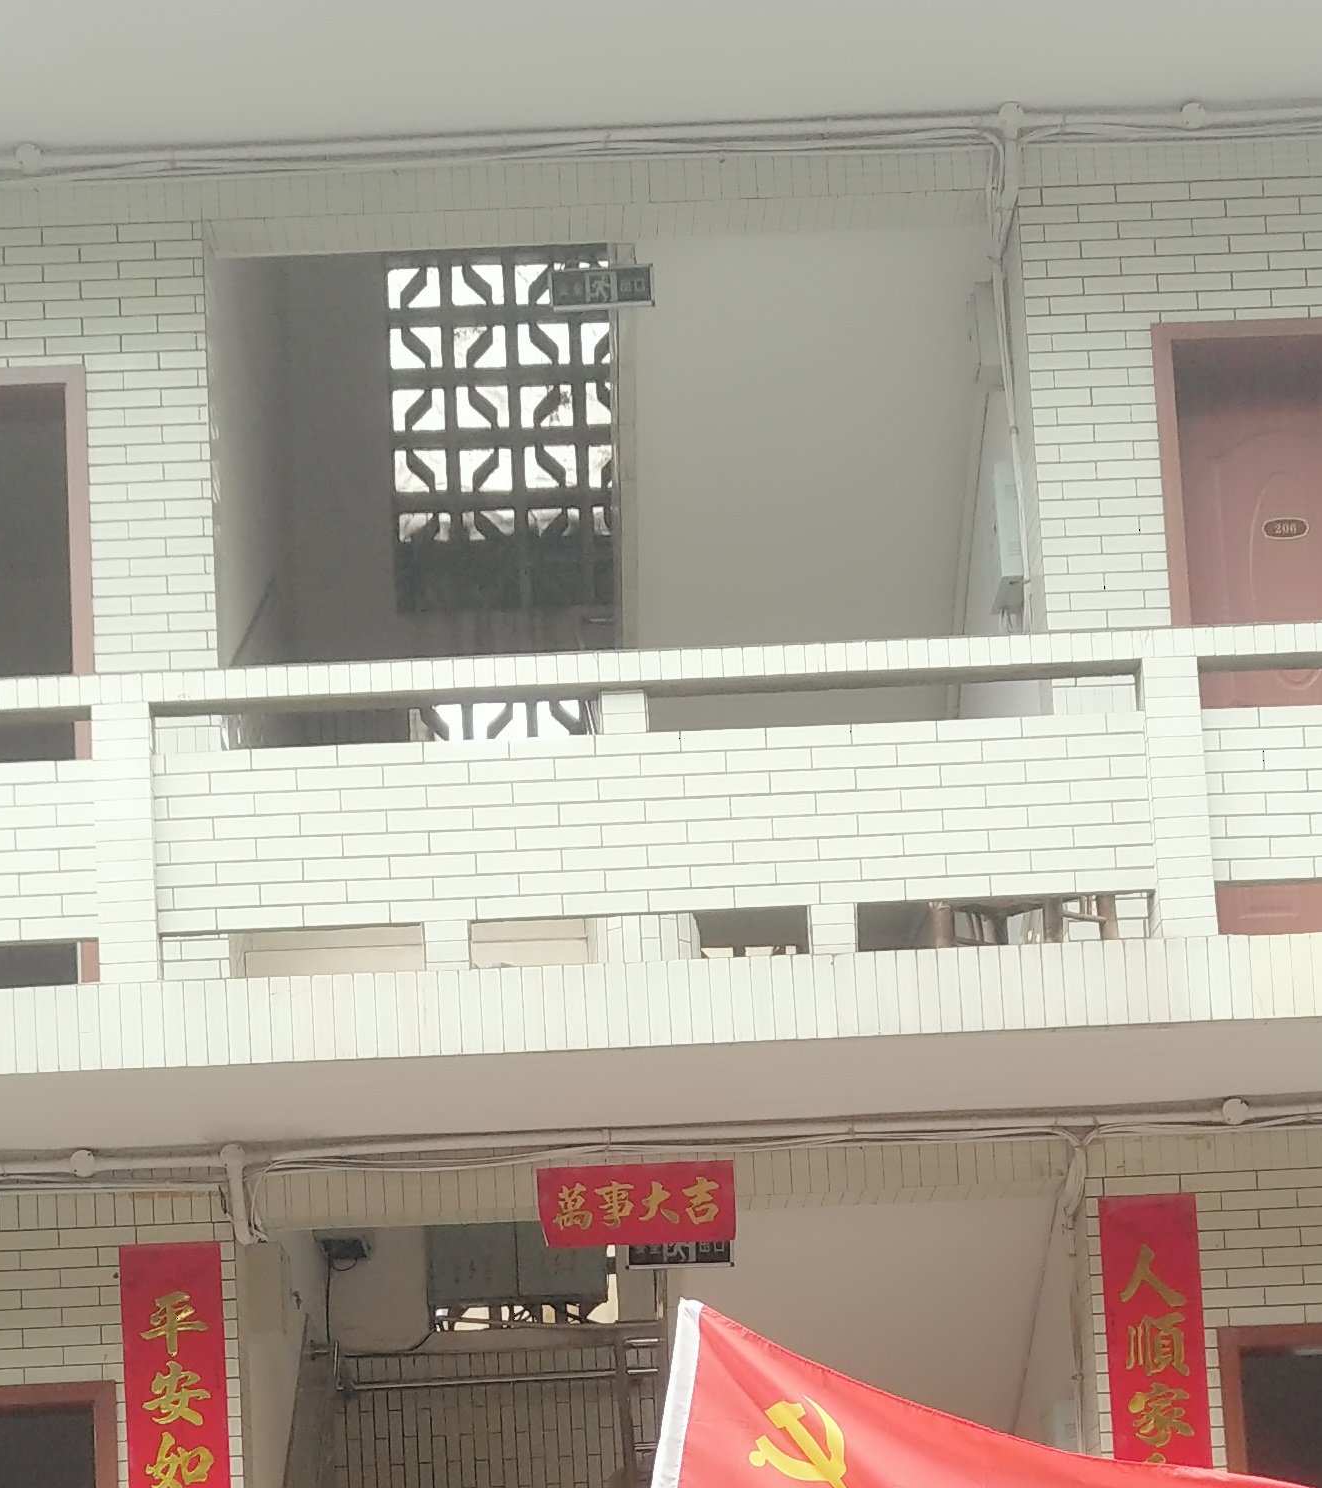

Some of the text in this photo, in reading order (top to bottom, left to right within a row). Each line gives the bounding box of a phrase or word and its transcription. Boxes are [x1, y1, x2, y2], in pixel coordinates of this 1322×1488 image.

[553, 1176, 720, 1231] 萬事大吉
[1119, 1244, 1195, 1463] 人順家
